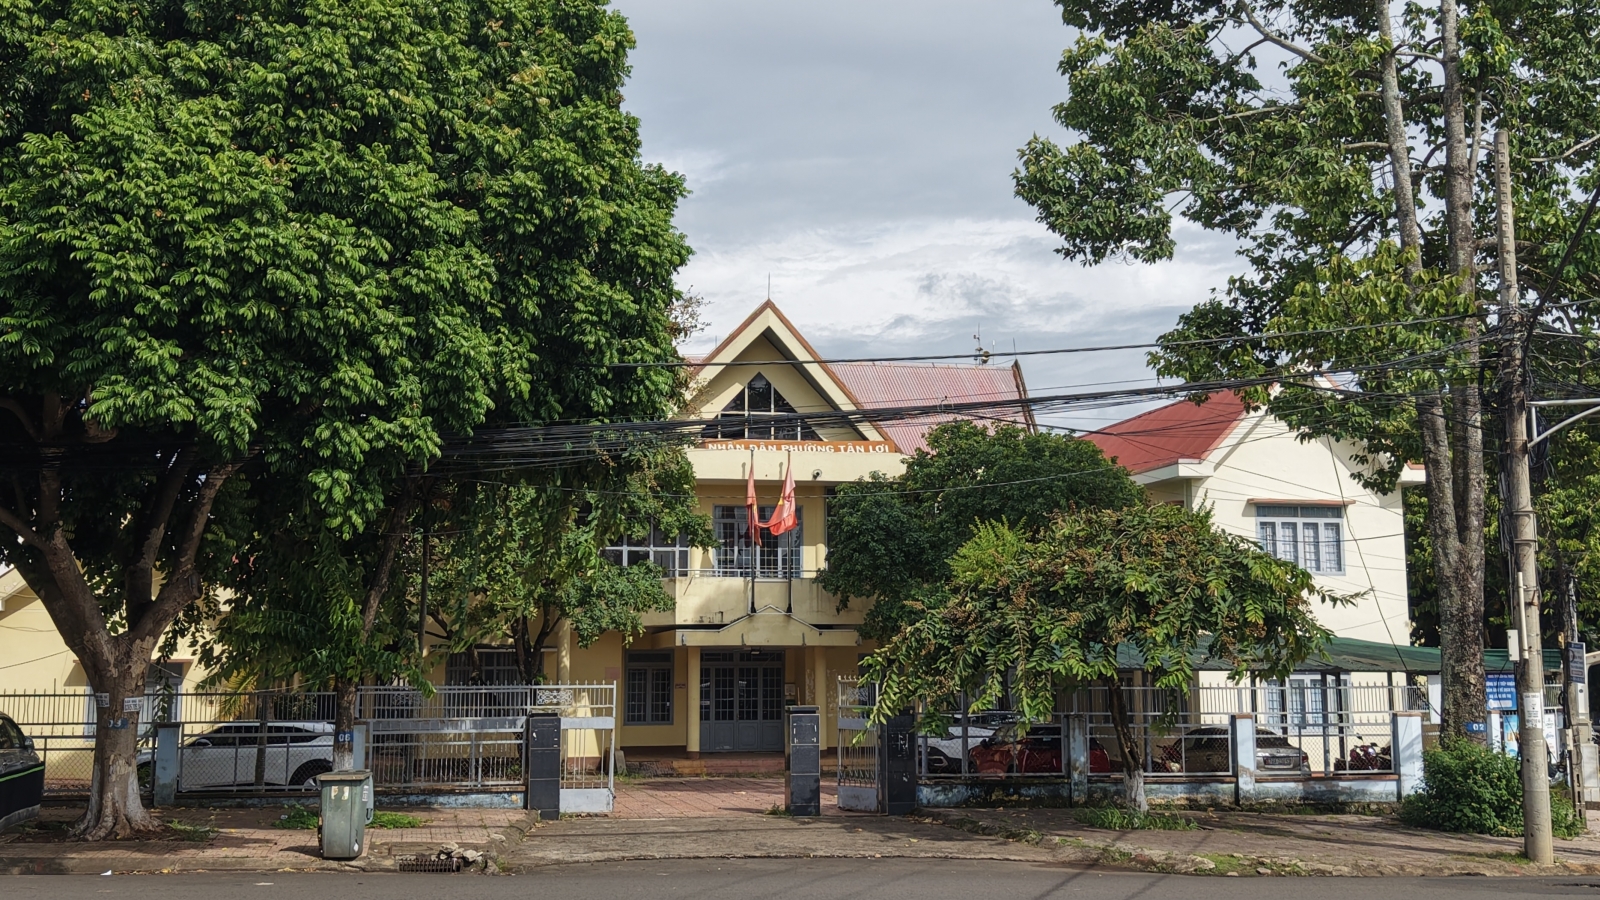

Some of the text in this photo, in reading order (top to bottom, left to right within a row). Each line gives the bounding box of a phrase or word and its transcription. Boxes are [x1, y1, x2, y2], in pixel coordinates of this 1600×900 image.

[708, 442, 745, 450] NHÂN
[781, 443, 835, 452] PHƯỜNG
[838, 443, 864, 453] TÂN
[1472, 723, 1485, 731] 02
